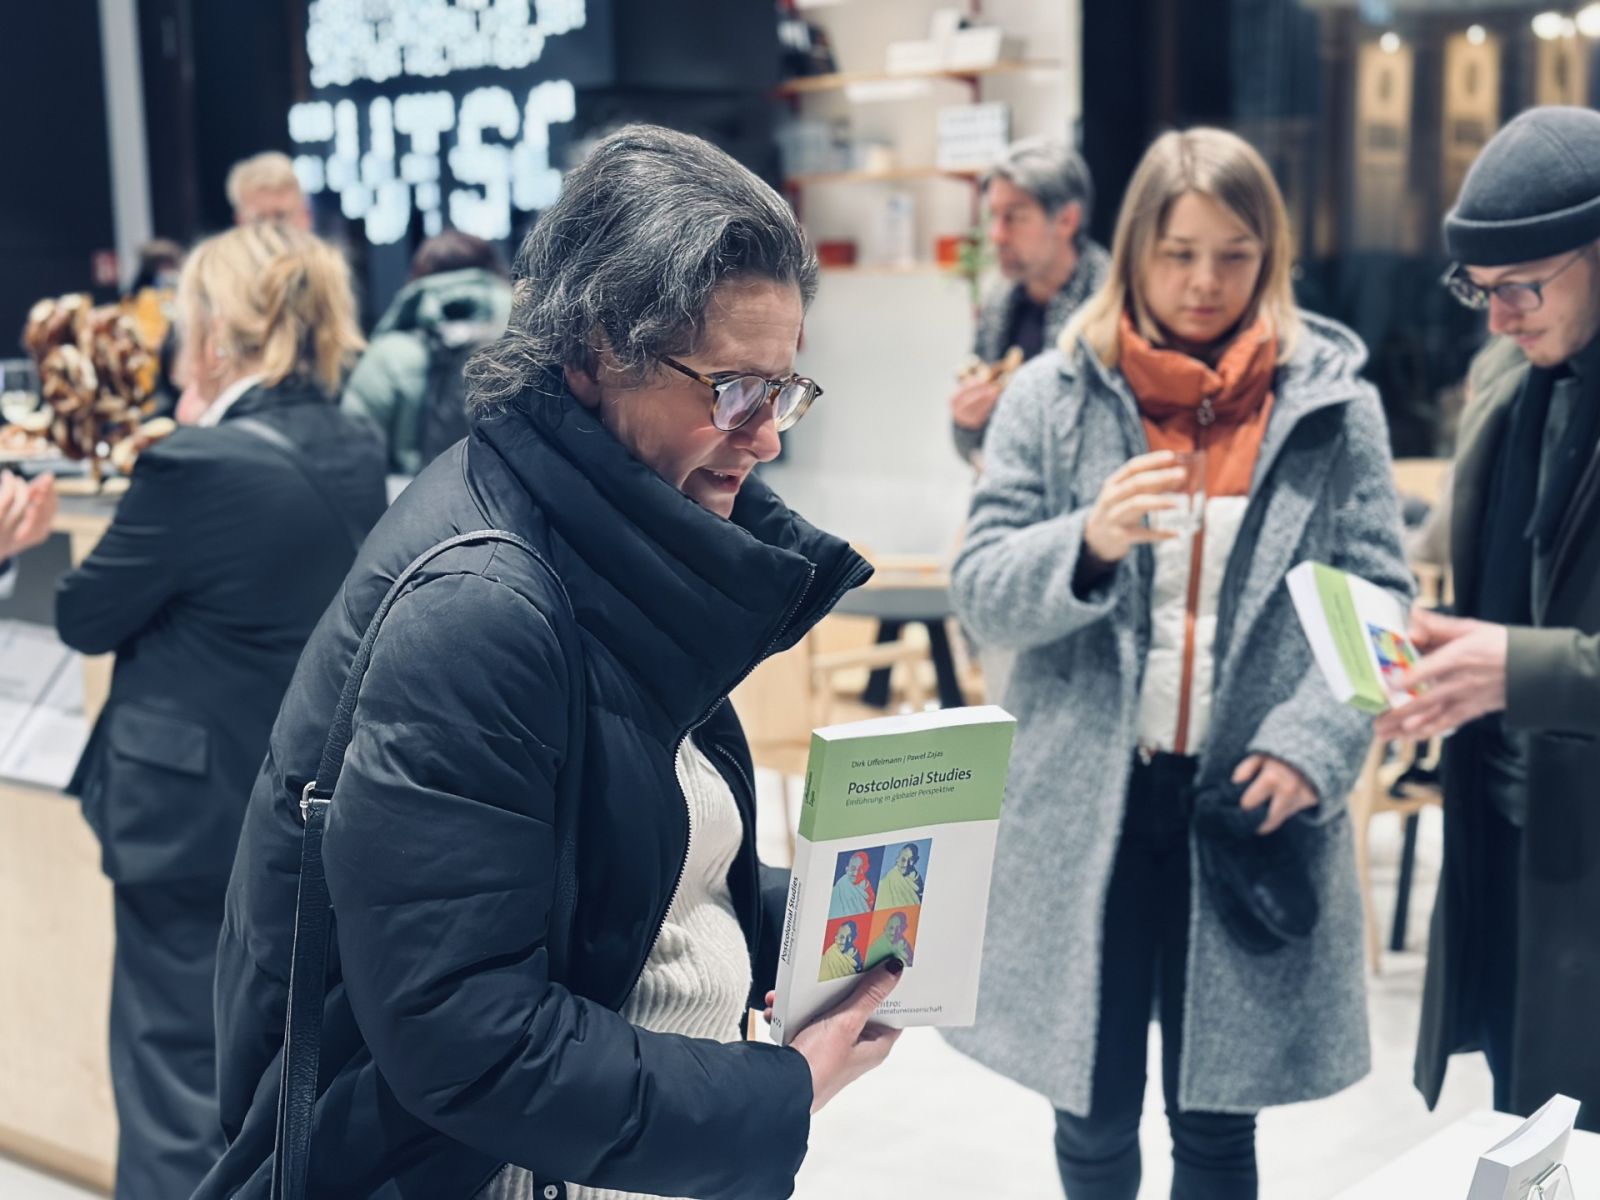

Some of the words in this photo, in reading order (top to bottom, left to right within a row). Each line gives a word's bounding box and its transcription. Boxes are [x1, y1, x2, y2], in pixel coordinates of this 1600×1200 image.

[851, 760, 866, 769] Dirk
[867, 756, 903, 768] Uffelmann
[927, 750, 944, 761] Zajas
[847, 771, 924, 795] Postcolonial
[926, 767, 972, 785] Studies
[845, 794, 884, 807] Einführung
[884, 793, 891, 801] in
[891, 789, 918, 803] globaler
[917, 785, 955, 797] Perspektive
[780, 908, 793, 962] Postcolonial
[788, 876, 799, 909] Studies
